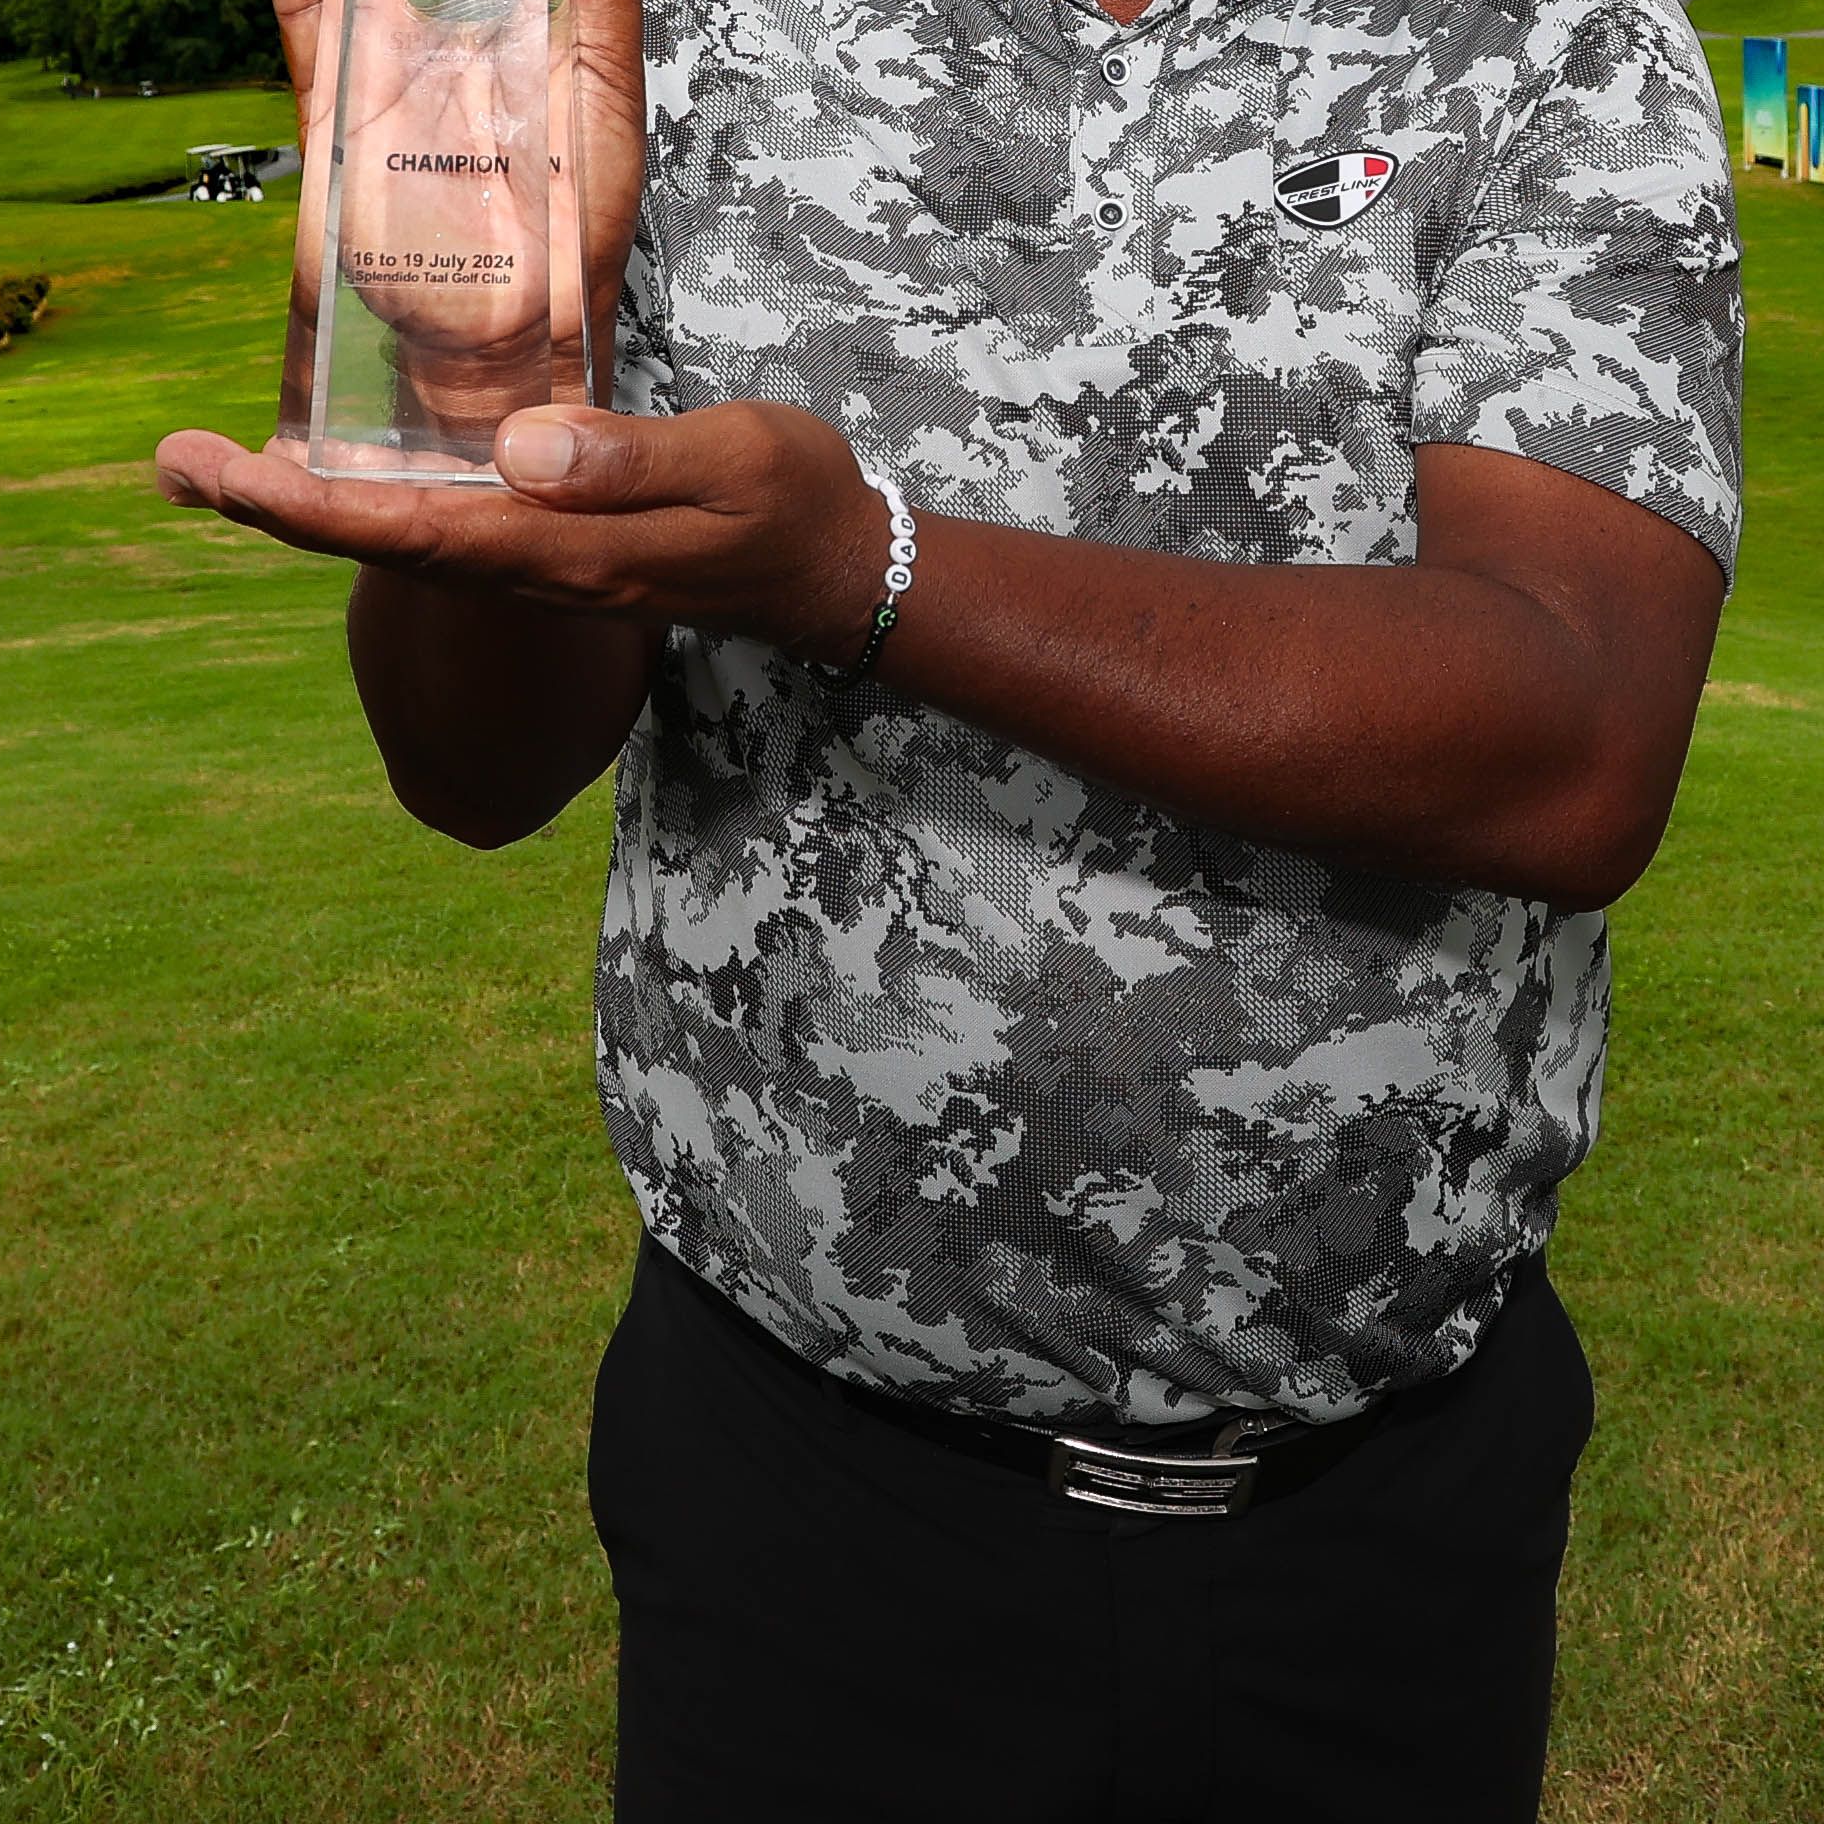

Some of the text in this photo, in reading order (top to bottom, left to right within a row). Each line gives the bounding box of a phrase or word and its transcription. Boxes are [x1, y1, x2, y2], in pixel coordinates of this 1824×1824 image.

[386, 153, 510, 174] CHAMPION
[352, 251, 515, 272] 16 to 19 July 2024
[355, 270, 512, 285] Splendido Taal Golf Club
[890, 517, 915, 587] DAD
